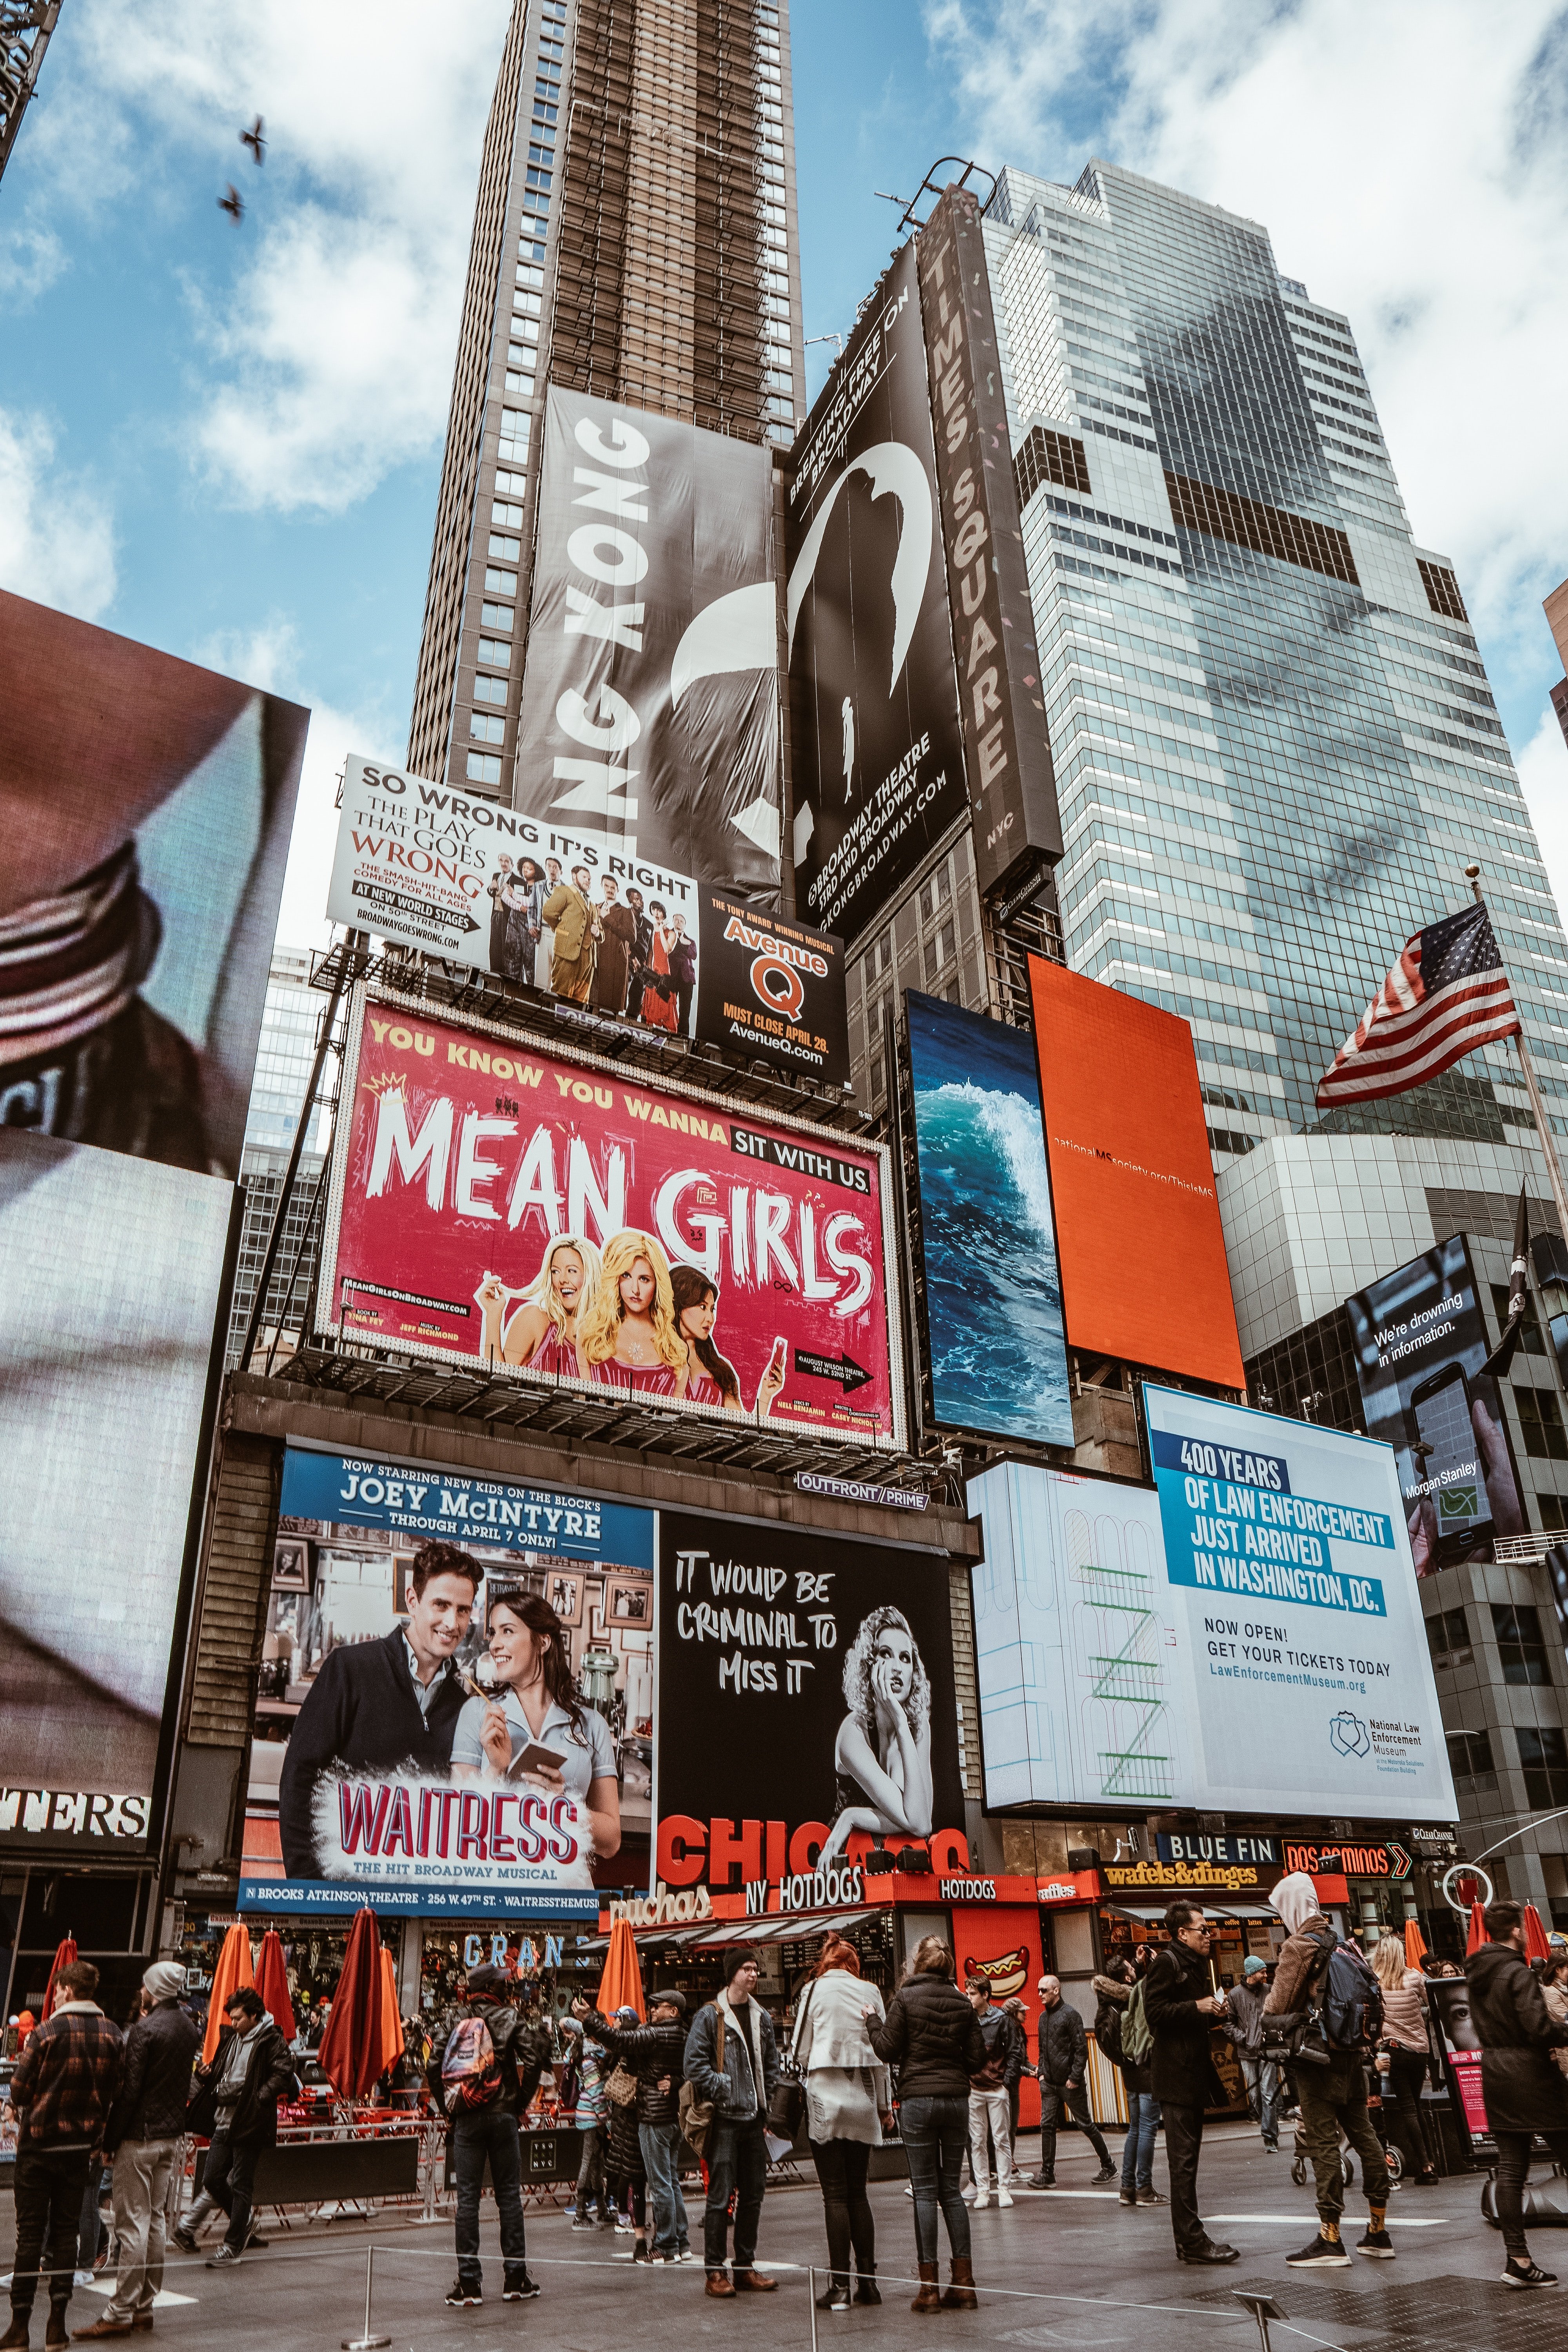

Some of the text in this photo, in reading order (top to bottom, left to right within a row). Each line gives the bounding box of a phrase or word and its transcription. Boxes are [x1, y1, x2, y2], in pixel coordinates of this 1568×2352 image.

[790, 285, 909, 506] BREAKING FREE ON
[812, 351, 880, 486] BROADWAY
[564, 417, 650, 653] KONG
[921, 237, 1008, 791] TIMES SQUARE
[362, 766, 690, 900] SO WRONG IT'S RIGHT
[368, 795, 478, 843] THE PLAY
[817, 731, 930, 894] BROADWAY THEATRE
[987, 812, 1013, 850] NYC
[354, 810, 485, 868] THAT GOES
[818, 770, 947, 933] GKONGBROADWAY.COM
[820, 768, 917, 912] 53RD AND BROADWAY
[350, 830, 483, 898] WRONG
[361, 862, 467, 902] THE SMASH-HIT-BANG
[354, 869, 472, 911] COMEDY FOR ALL AGES
[356, 884, 469, 929] AT NEW WORLD STAGES
[357, 908, 459, 950] BROADWAYGOESWRONG.COM
[370, 902, 446, 931] ON 50th STREET
[712, 898, 725, 911] THE
[727, 904, 744, 918] TONY
[775, 922, 804, 942] WINNING
[805, 935, 835, 955] MUSICAL
[724, 916, 828, 977] Avenue
[750, 954, 804, 1022] Q
[724, 1002, 829, 1054] MUST CLOSE APRIL 28.
[730, 1022, 823, 1065] AvenueQ.com
[370, 1019, 869, 1193] YOU KNOW YOU WANNA SIT WITH US.
[365, 1086, 872, 1315] MEAN GIRLS
[348, 1313, 384, 1327] TINA FEY
[400, 1323, 459, 1341] JEFF RICHMOND
[1374, 1292, 1463, 1347] We're drowning
[1378, 1321, 1455, 1368] in information.
[803, 1357, 865, 1379] AUGUST WILSON THEATRE,
[831, 1370, 844, 1379] 52ND
[777, 1401, 825, 1417] NELL BENJAMIN
[831, 1412, 850, 1422] CASEY
[342, 1459, 601, 1512] NOW STARRING NEW KIDS ON THE BLOCK'S
[1181, 1440, 1282, 1491] 400 YEARS
[1406, 1462, 1476, 1499] Morgan Stanley
[340, 1474, 428, 1511] JOEY
[801, 1475, 924, 1508] OUTFRONT PRIME
[1185, 1476, 1385, 1545] OF LAW ENFORCEMENT
[389, 1512, 556, 1548] THROUGH APRIL 7 ONLY!
[1190, 1514, 1323, 1568] JUST ARRIVED
[676, 1551, 835, 1603] IT WOULD BE
[1193, 1551, 1380, 1612] IN WASHINGTON, DC.
[678, 1602, 837, 1649] CRIMINAL TO
[1204, 1617, 1288, 1642] NOW OPEN!
[719, 1650, 815, 1695] MISS IT
[1208, 1641, 1390, 1677] GET YOUR TICKETS TODAY
[1210, 1662, 1366, 1695] LawEnforcementMuseum.org
[1370, 1719, 1419, 1733] National Law
[1372, 1731, 1421, 1746] Enforcement
[1373, 1744, 1407, 1757] Museum
[1400, 1766, 1416, 1775] Building
[338, 1782, 578, 1864] WAITRESS
[354, 1861, 557, 1880] THE HIT BROADWAY MUSICAL
[1170, 1836, 1272, 1861] BLUE FIN
[1287, 1846, 1318, 1872] DOS
[258, 1887, 495, 1906] BROOKS ATKINSON THEATRE 256 W. 47TH ST.
[746, 1866, 861, 1914] NY HOTDOGS
[941, 1879, 996, 1899] HOTDOGS
[1104, 1862, 1257, 1889] wafels&dinges
[534, 2160, 552, 2168] NYC
